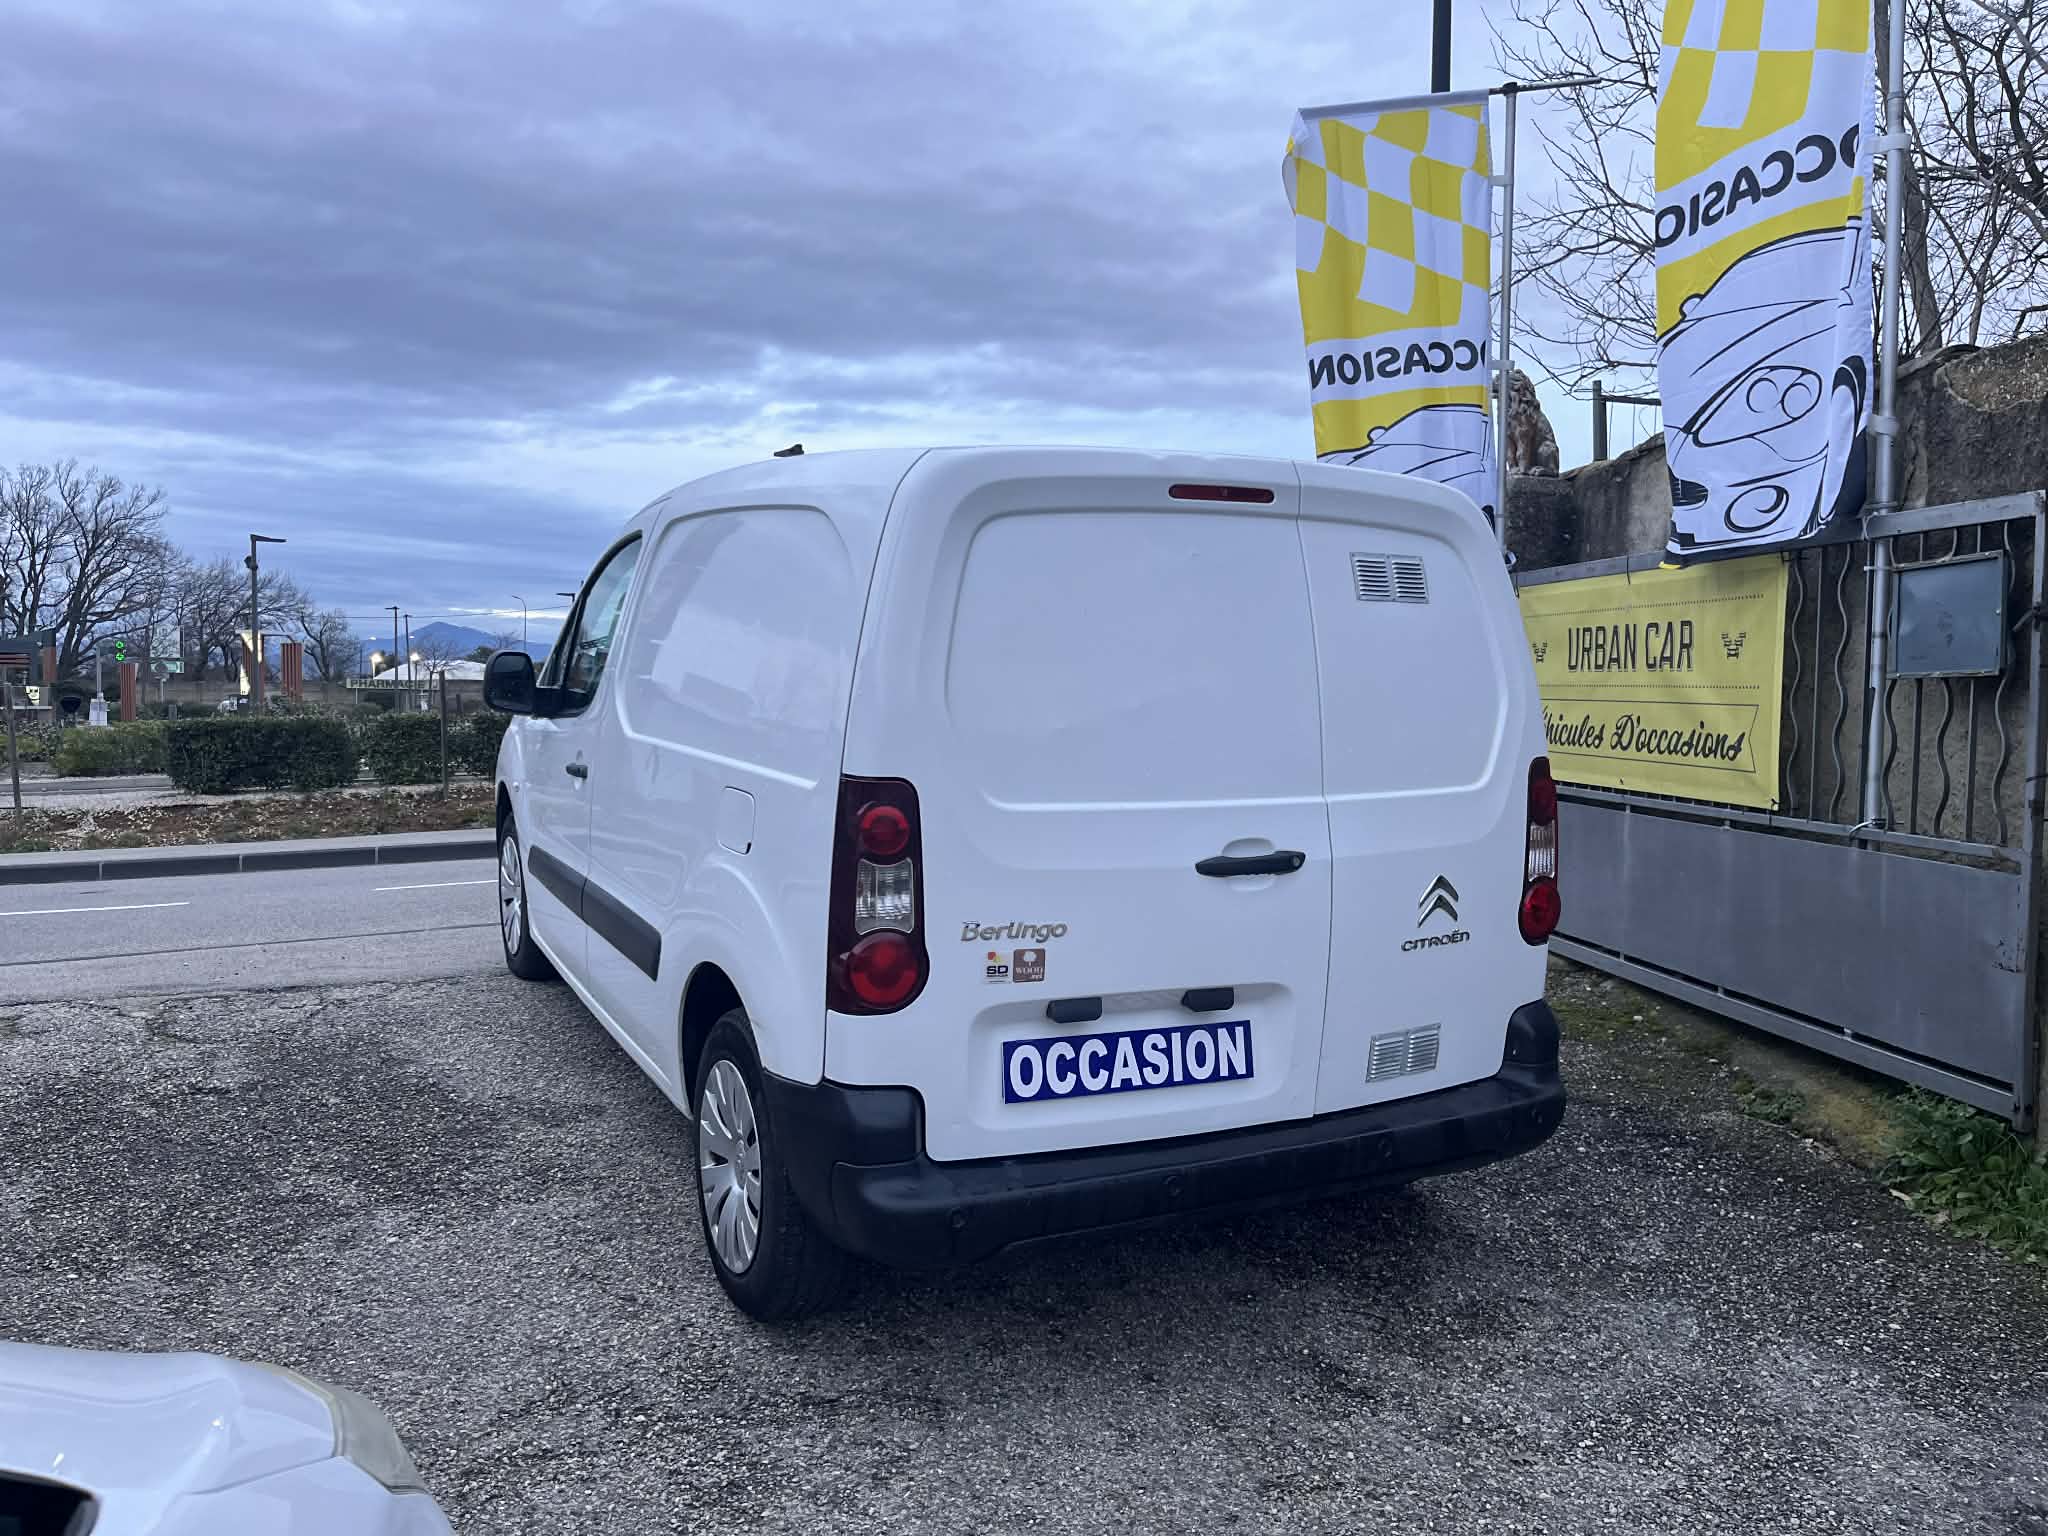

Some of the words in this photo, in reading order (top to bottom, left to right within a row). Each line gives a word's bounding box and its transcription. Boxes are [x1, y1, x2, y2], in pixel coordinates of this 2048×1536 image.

[1567, 623, 1637, 672] URBAN
[1645, 620, 1694, 672] CAR
[351, 680, 426, 689] PHARMACE
[1543, 705, 1606, 749] hicules
[1609, 714, 1746, 761] D'occasions
[959, 921, 1068, 943] Berlingo
[986, 965, 1009, 975] SD
[1009, 1025, 1247, 1098] OCCASION
